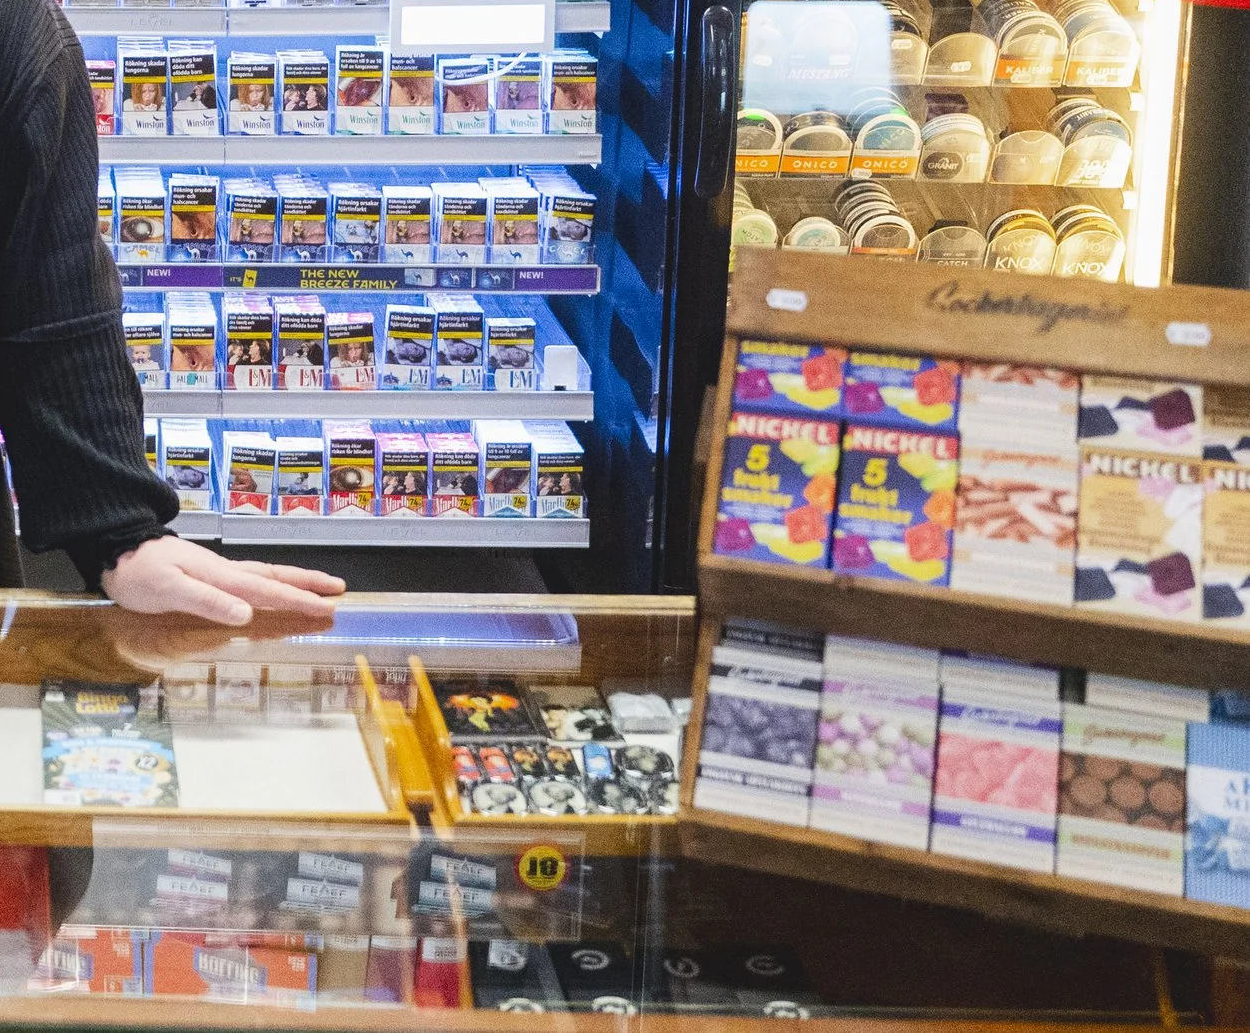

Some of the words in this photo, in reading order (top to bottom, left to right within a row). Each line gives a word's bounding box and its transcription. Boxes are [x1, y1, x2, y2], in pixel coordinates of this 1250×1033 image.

[136, 119, 164, 129] Winston
[242, 120, 271, 129] Winston
[296, 119, 325, 129] Winston
[564, 118, 593, 128] Winston
[995, 256, 1042, 270] KNOX
[147, 269, 171, 277] NEW!
[300, 269, 327, 279] THE
[331, 269, 359, 279] NEW
[519, 271, 544, 280] NEW!
[300, 279, 350, 289] BREEZE
[353, 279, 398, 289] FAMILY
[746, 444, 771, 471] 5
